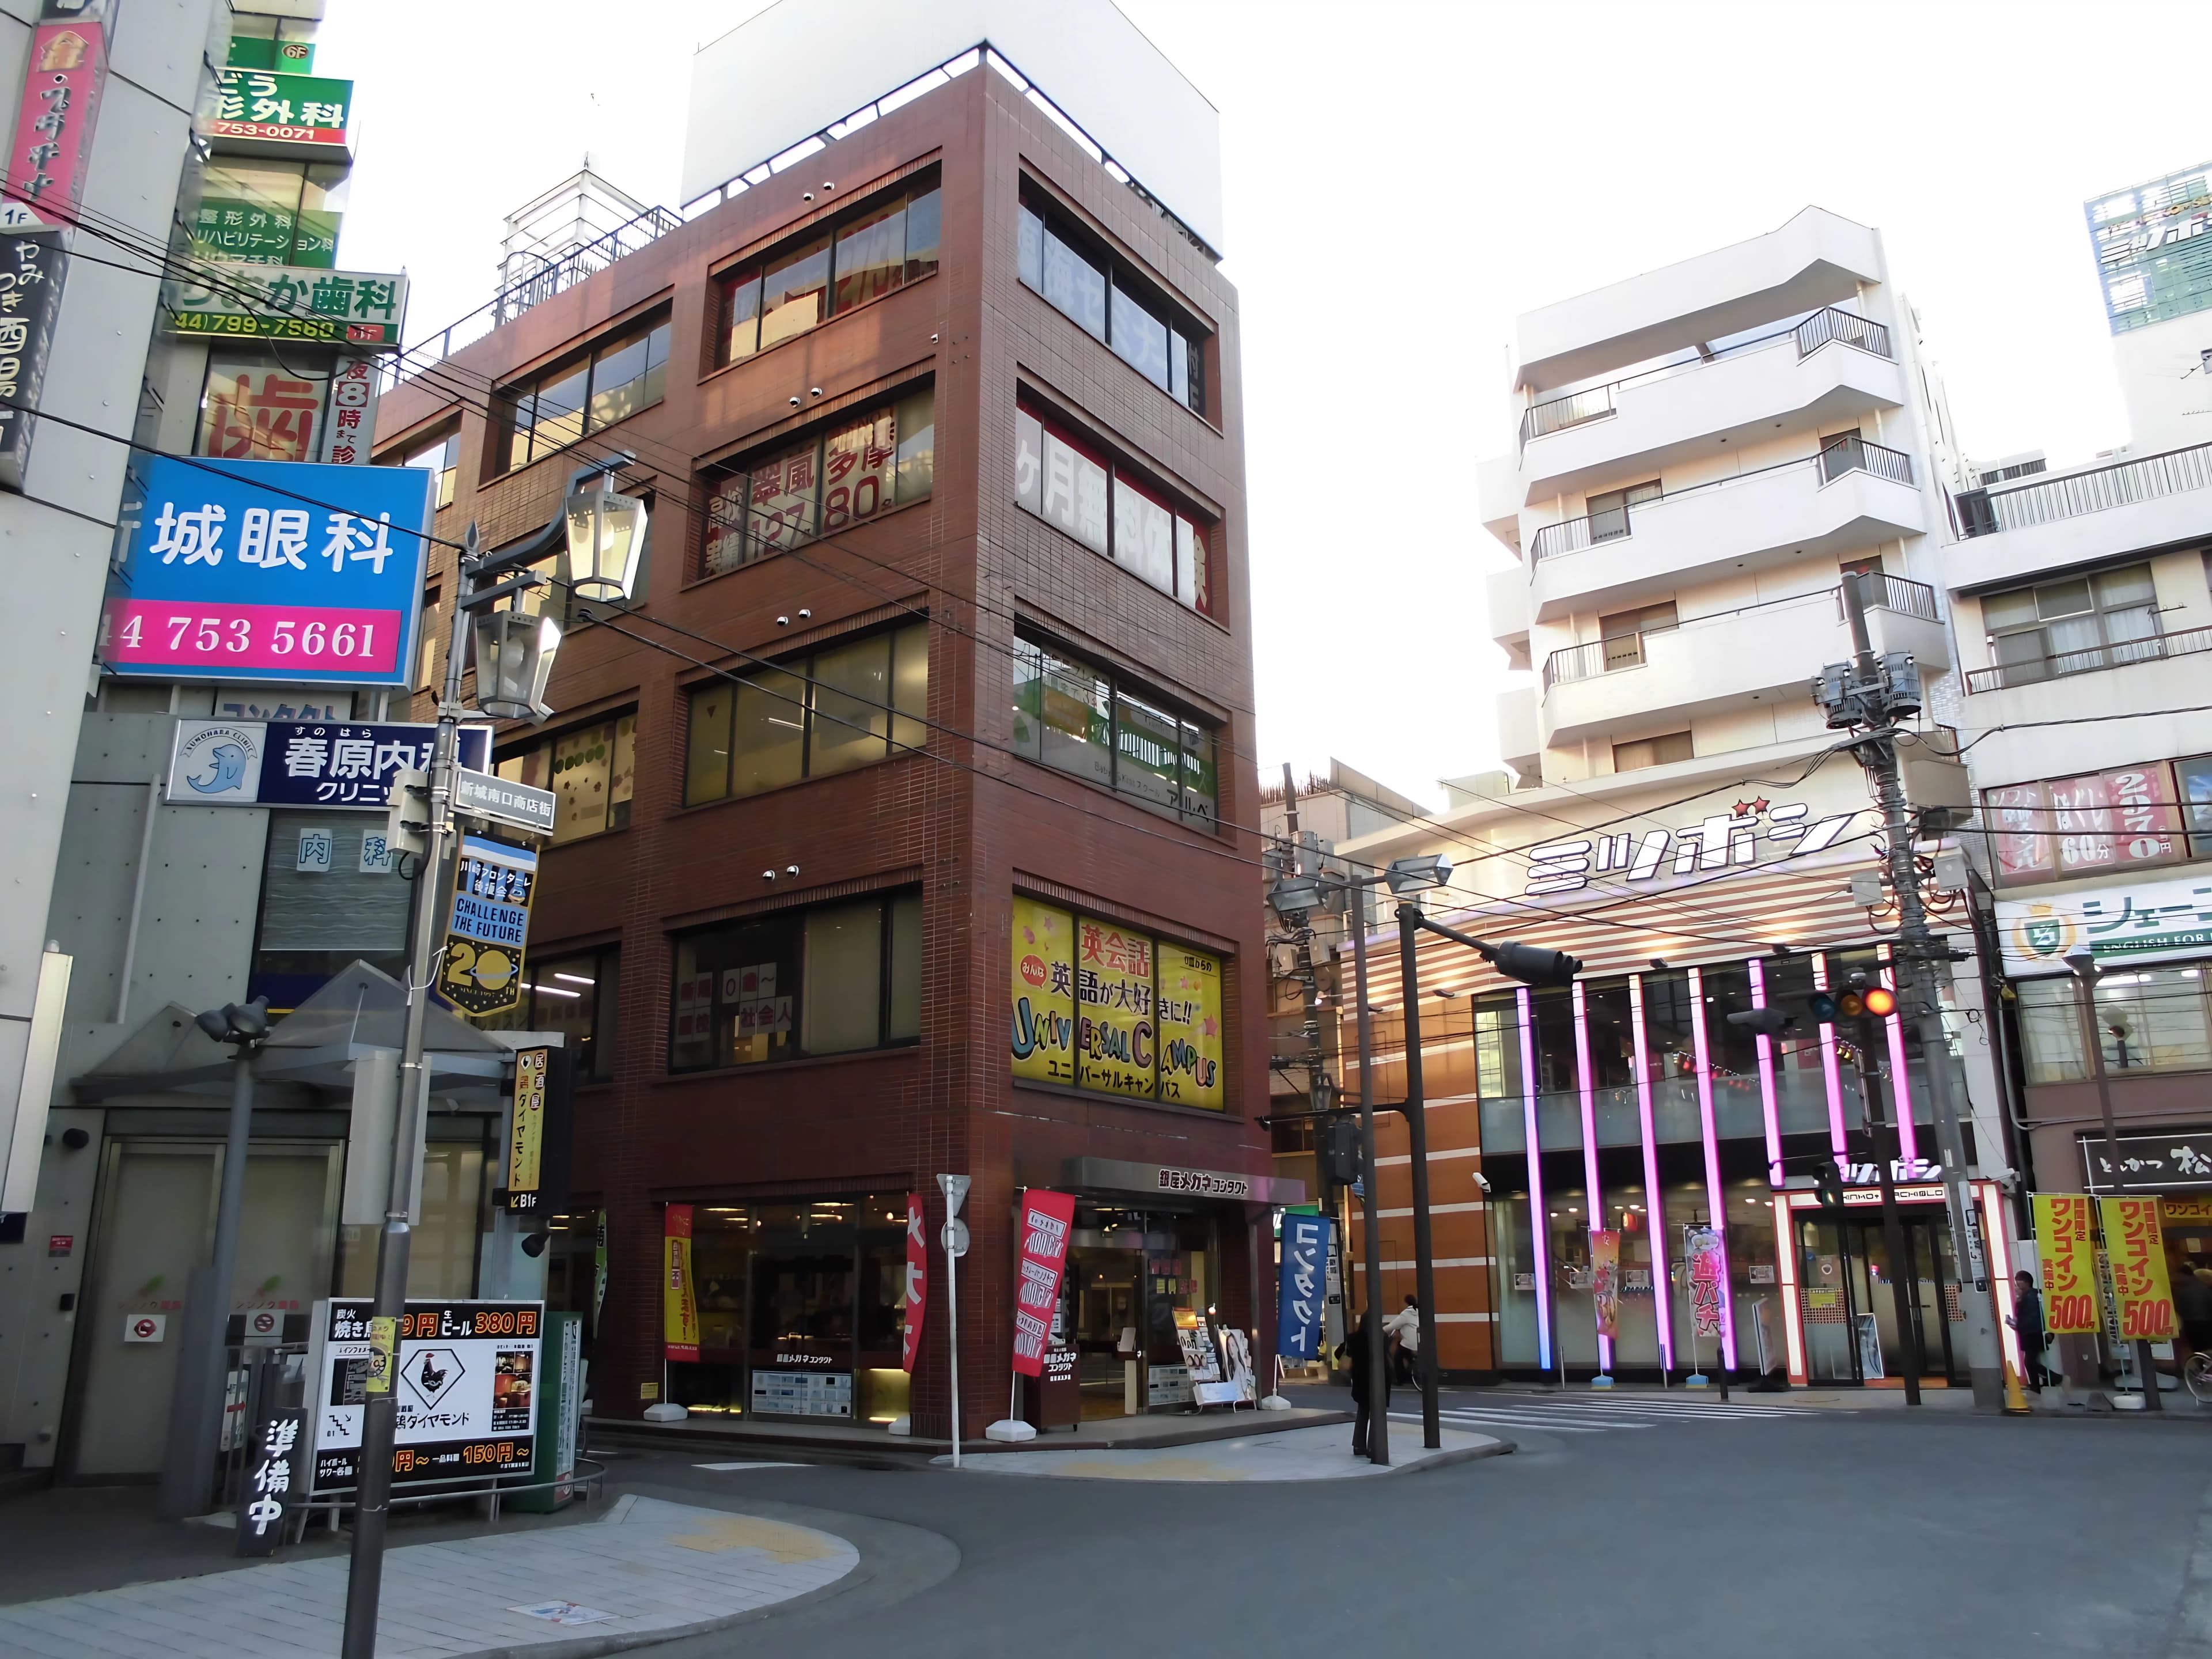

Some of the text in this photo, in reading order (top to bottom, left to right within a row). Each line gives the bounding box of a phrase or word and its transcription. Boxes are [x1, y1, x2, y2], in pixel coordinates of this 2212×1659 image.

[287, 46, 306, 58] 6F
[5, 209, 28, 226] 1F
[197, 229, 334, 252] リハビリテーション科
[168, 617, 251, 652] 753
[271, 621, 374, 657] 5661
[460, 780, 552, 817] 新城南口商店街
[300, 834, 330, 864] 内
[457, 897, 525, 927] CHALLENGE
[454, 915, 522, 943] THE FUTURE
[1081, 924, 1150, 978] 英会話
[1022, 961, 1044, 978] みんな
[520, 1194, 537, 1208] B1F
[2050, 1198, 2078, 1291] ワンコイン
[2119, 1202, 2153, 1296] ワンコイン
[1291, 1223, 1319, 1352] コンタクト
[442, 1320, 472, 1336] ビール
[475, 1311, 537, 1335] 380円
[248, 1419, 298, 1536] 準備中
